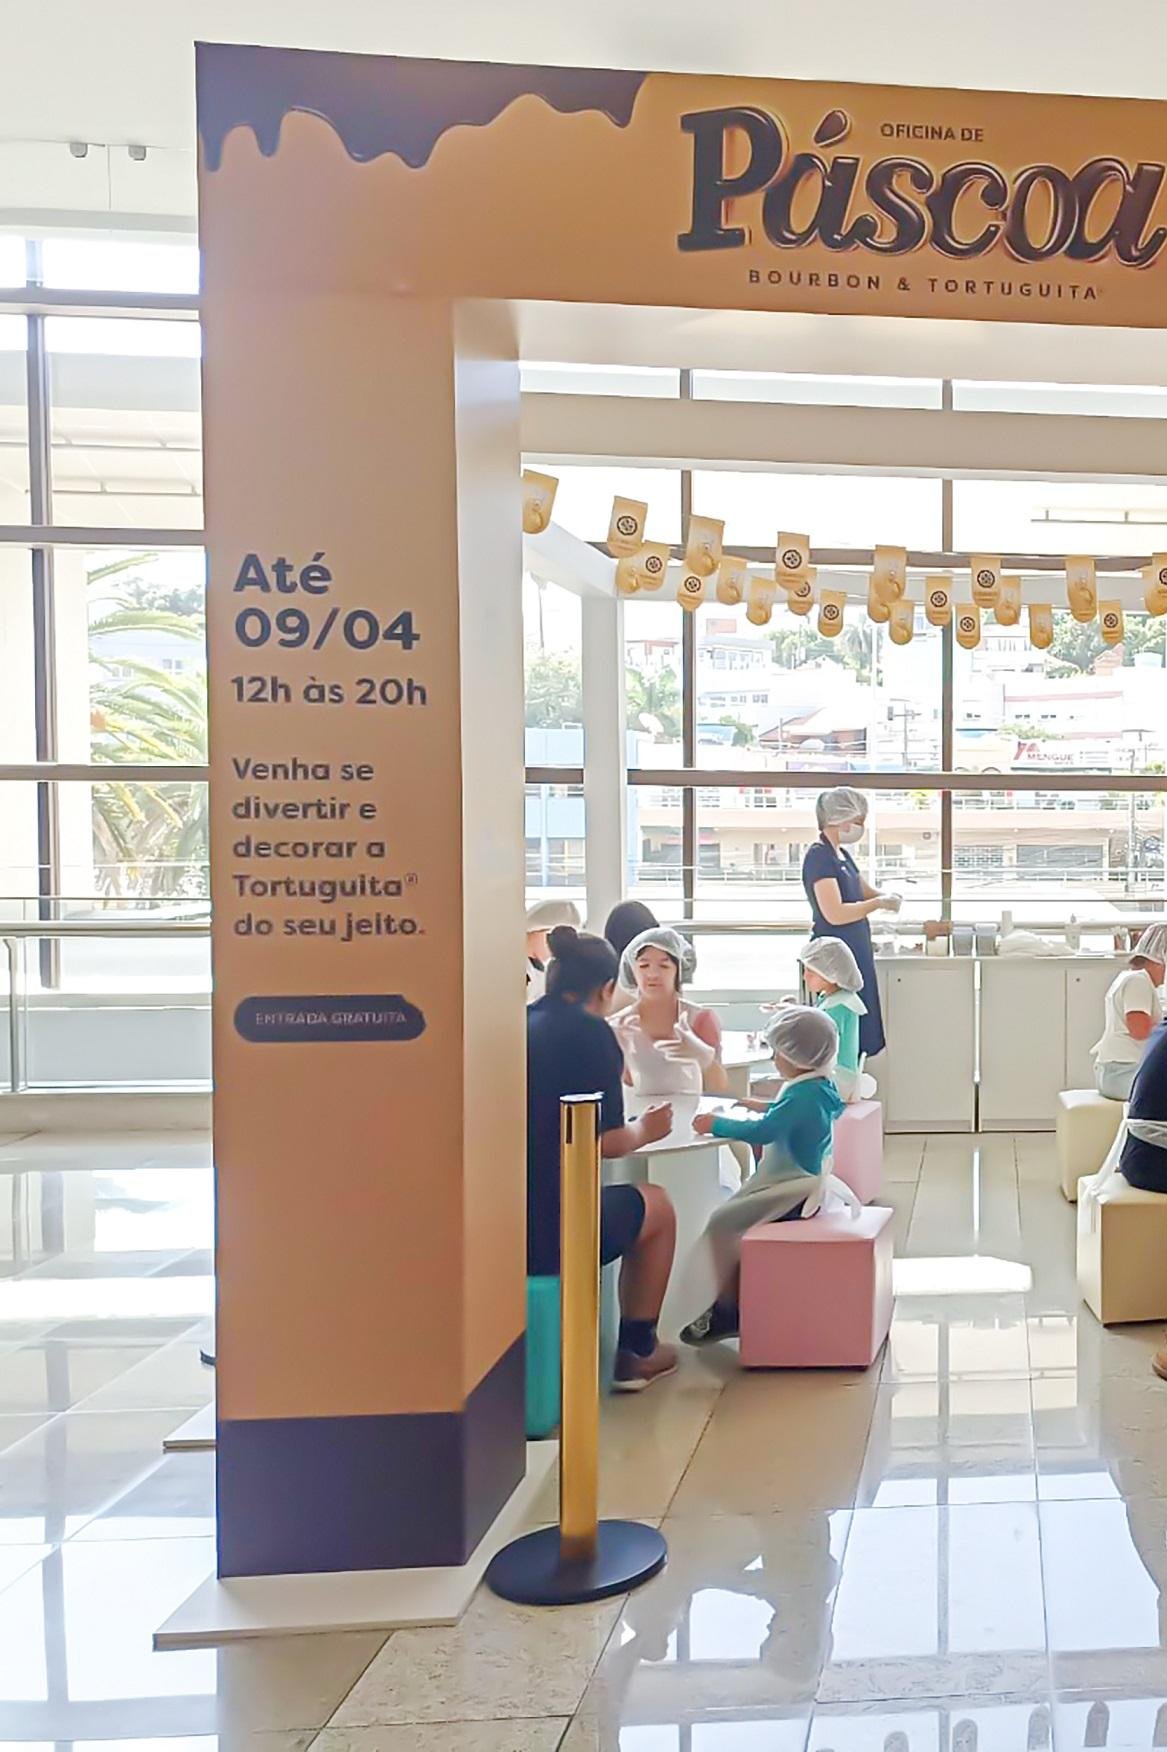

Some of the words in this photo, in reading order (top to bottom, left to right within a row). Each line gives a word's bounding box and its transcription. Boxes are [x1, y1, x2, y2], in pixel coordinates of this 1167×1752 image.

[879, 122, 956, 142] OFICINA
[960, 126, 985, 143] DE
[748, 269, 881, 291] BOURBON
[897, 277, 911, 292] &
[928, 278, 1098, 300] TORTUGUITA
[233, 552, 333, 594] Até
[235, 607, 421, 650] 09/04
[230, 675, 292, 703] 12h
[303, 676, 344, 704] às
[355, 677, 427, 705] 20h
[231, 757, 330, 781] Venha
[340, 762, 374, 781] se
[232, 797, 350, 820] divertir
[359, 801, 377, 820] e
[232, 835, 357, 858] decorar
[366, 840, 385, 858] a
[233, 913, 273, 936] do
[284, 917, 336, 936] seu
[340, 912, 426, 941] jeito.
[256, 1012, 327, 1025] ENTRADA
[332, 1011, 407, 1025] GRATUITA
